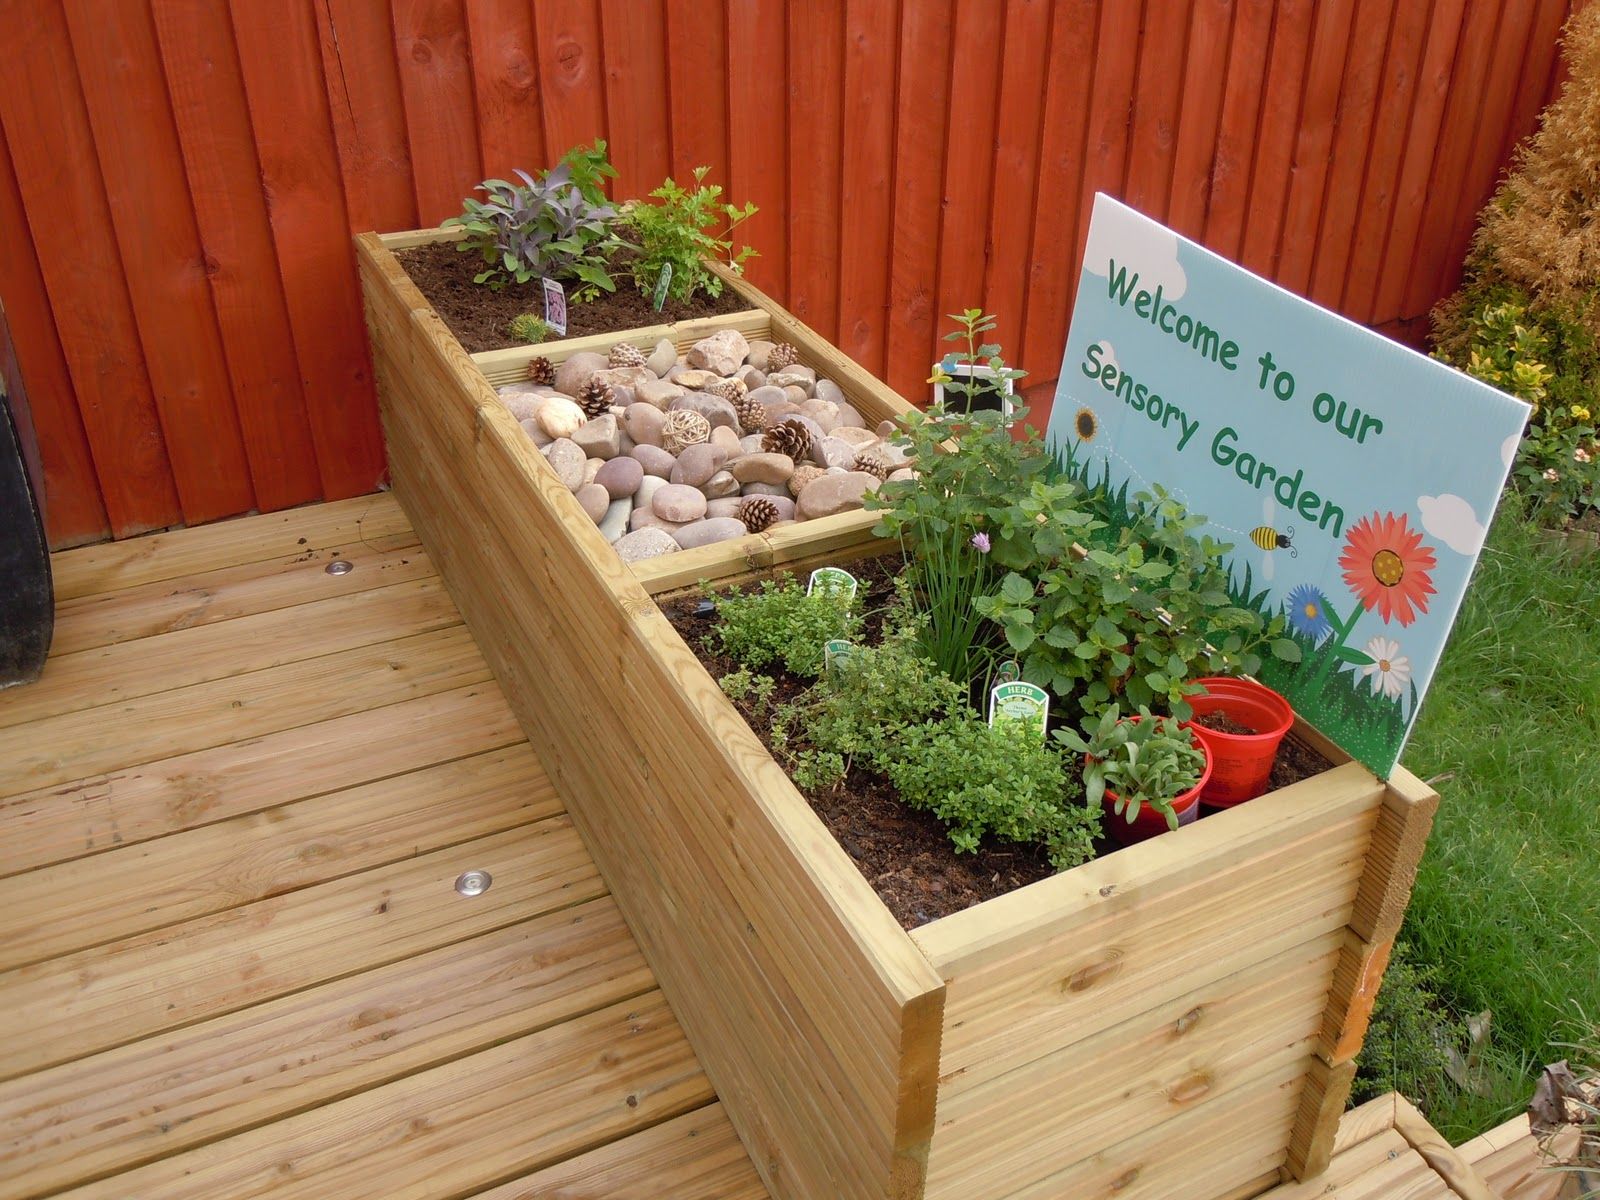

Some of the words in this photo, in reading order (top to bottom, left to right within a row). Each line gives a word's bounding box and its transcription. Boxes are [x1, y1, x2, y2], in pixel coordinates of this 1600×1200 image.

[1081, 343, 1200, 452] Sensory
[1211, 427, 1345, 538] Garden
[1108, 258, 1240, 371] Welcome
[1258, 352, 1296, 401] to
[1312, 392, 1384, 444] our
[1007, 686, 1034, 696] HERB
